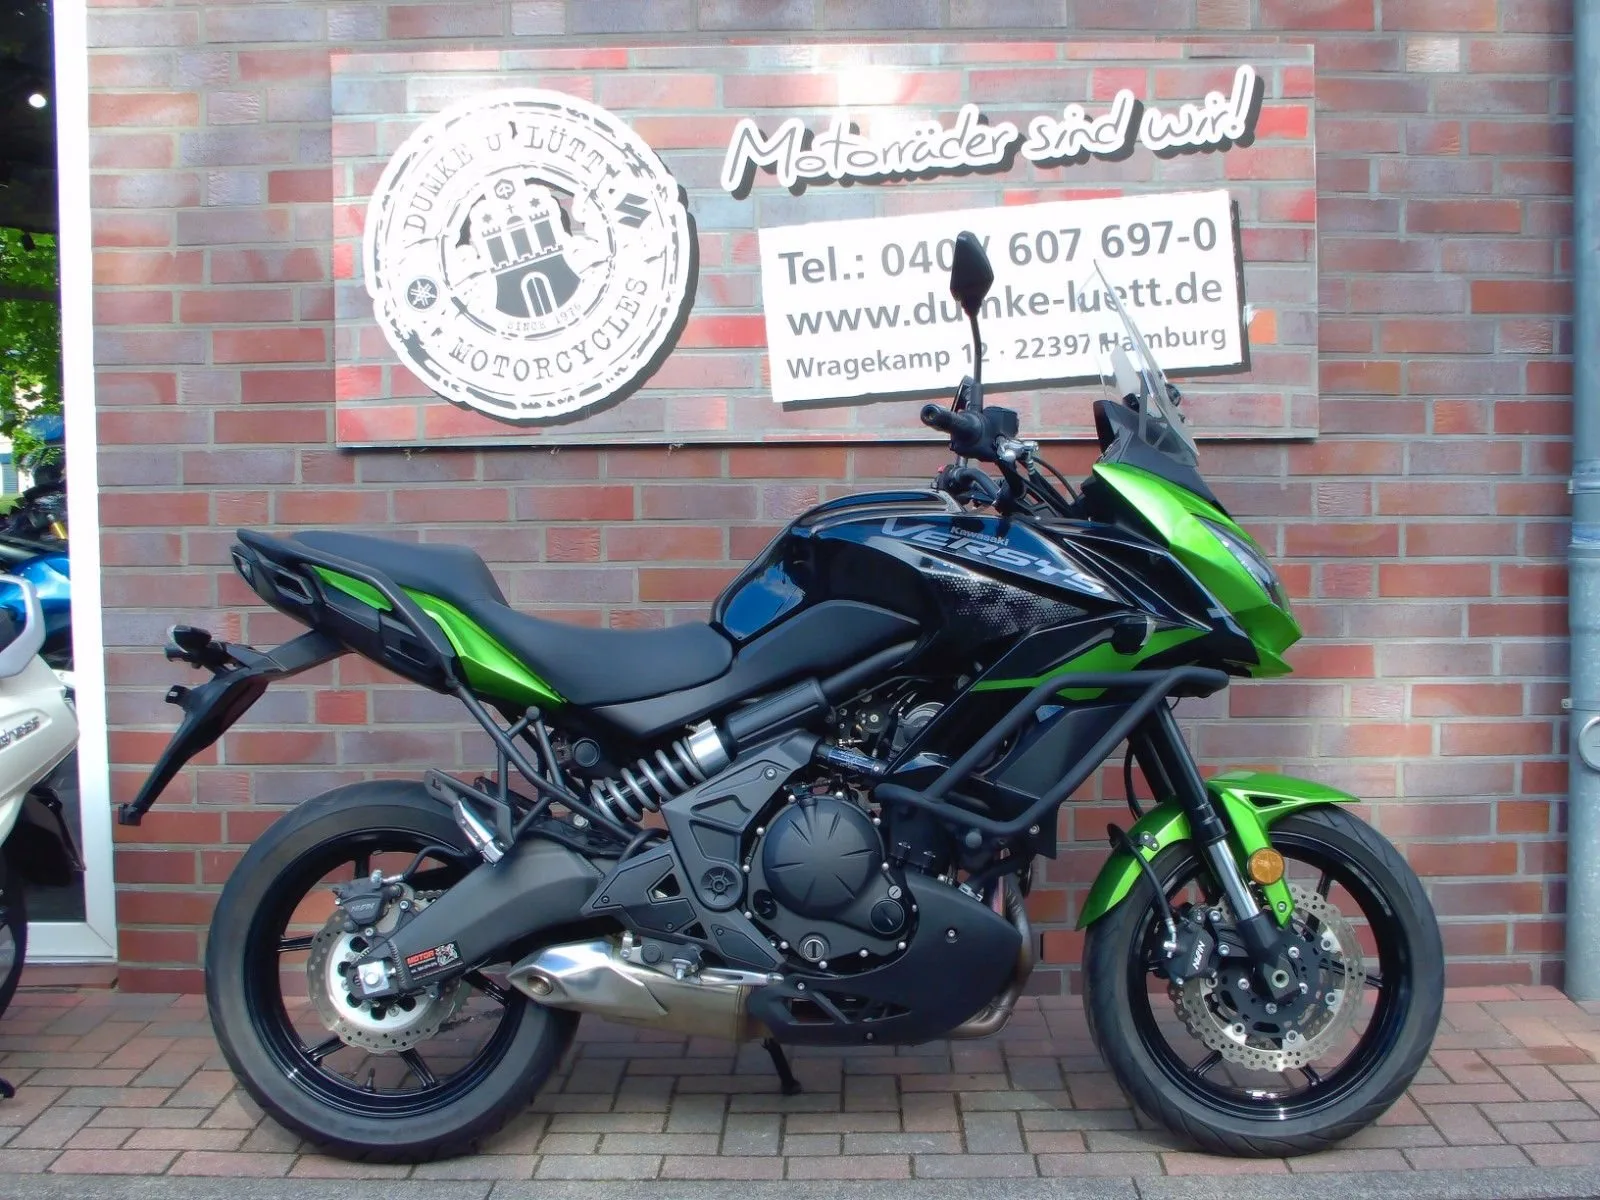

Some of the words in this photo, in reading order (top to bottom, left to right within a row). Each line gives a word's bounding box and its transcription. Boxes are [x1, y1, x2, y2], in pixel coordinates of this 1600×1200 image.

[724, 106, 1016, 190] Motorräder
[1022, 89, 1135, 162] sind
[1141, 65, 1256, 149] wir!
[403, 143, 473, 234] DUMKE
[523, 126, 604, 173] LÜTT
[778, 249, 866, 286] Tel.:
[881, 238, 956, 278] 040
[1009, 227, 1082, 266] 607
[1102, 217, 1217, 259] 697-0
[448, 277, 648, 382] MOTORCYCLES
[786, 349, 950, 379] Wragekamp
[1014, 333, 1091, 360] 22397
[881, 518, 1105, 594] VERSYS
[950, 526, 1009, 546] Kawasaki
